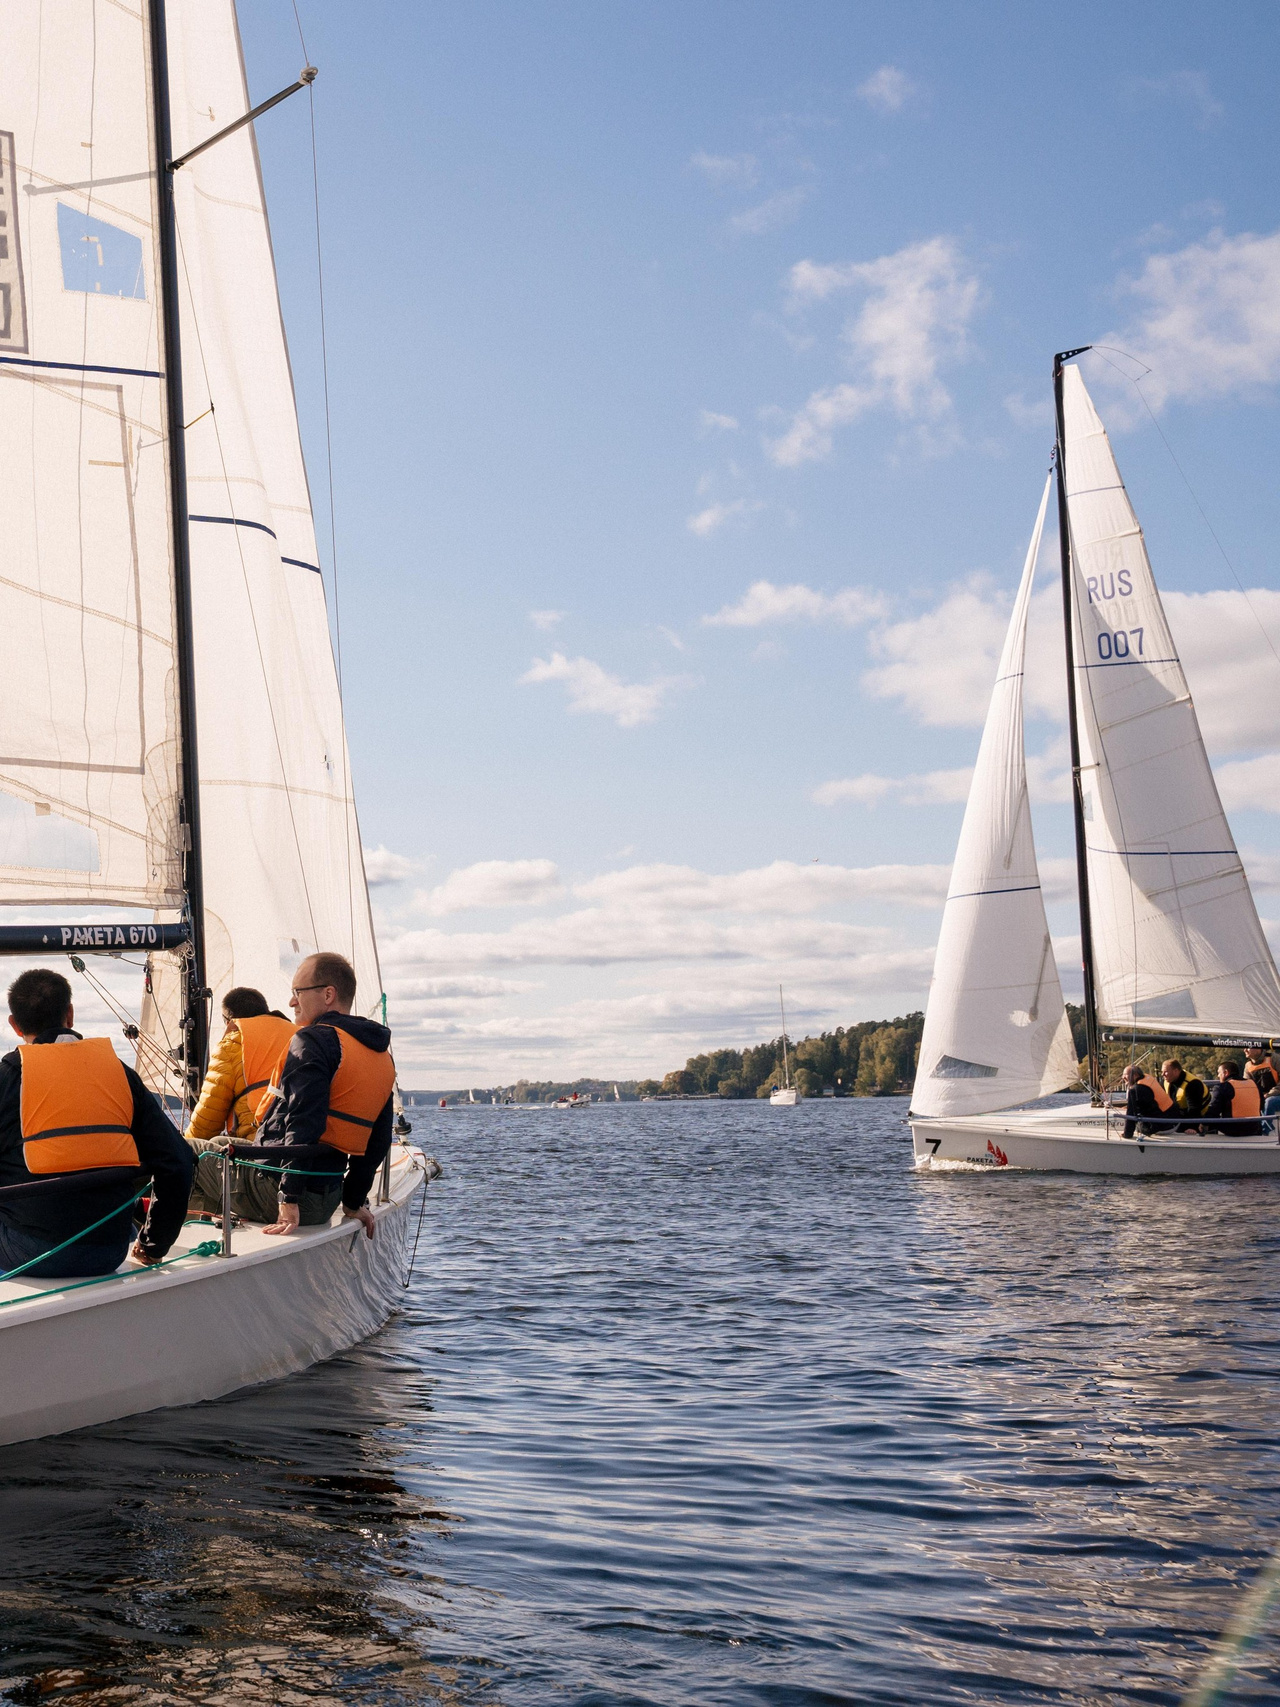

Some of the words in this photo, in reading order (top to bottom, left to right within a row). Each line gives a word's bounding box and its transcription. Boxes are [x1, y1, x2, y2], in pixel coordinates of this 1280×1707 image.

[1087, 569, 1133, 604] RUS
[1097, 627, 1144, 660] 007
[129, 926, 157, 944] 670
[925, 1138, 941, 1155] 7
